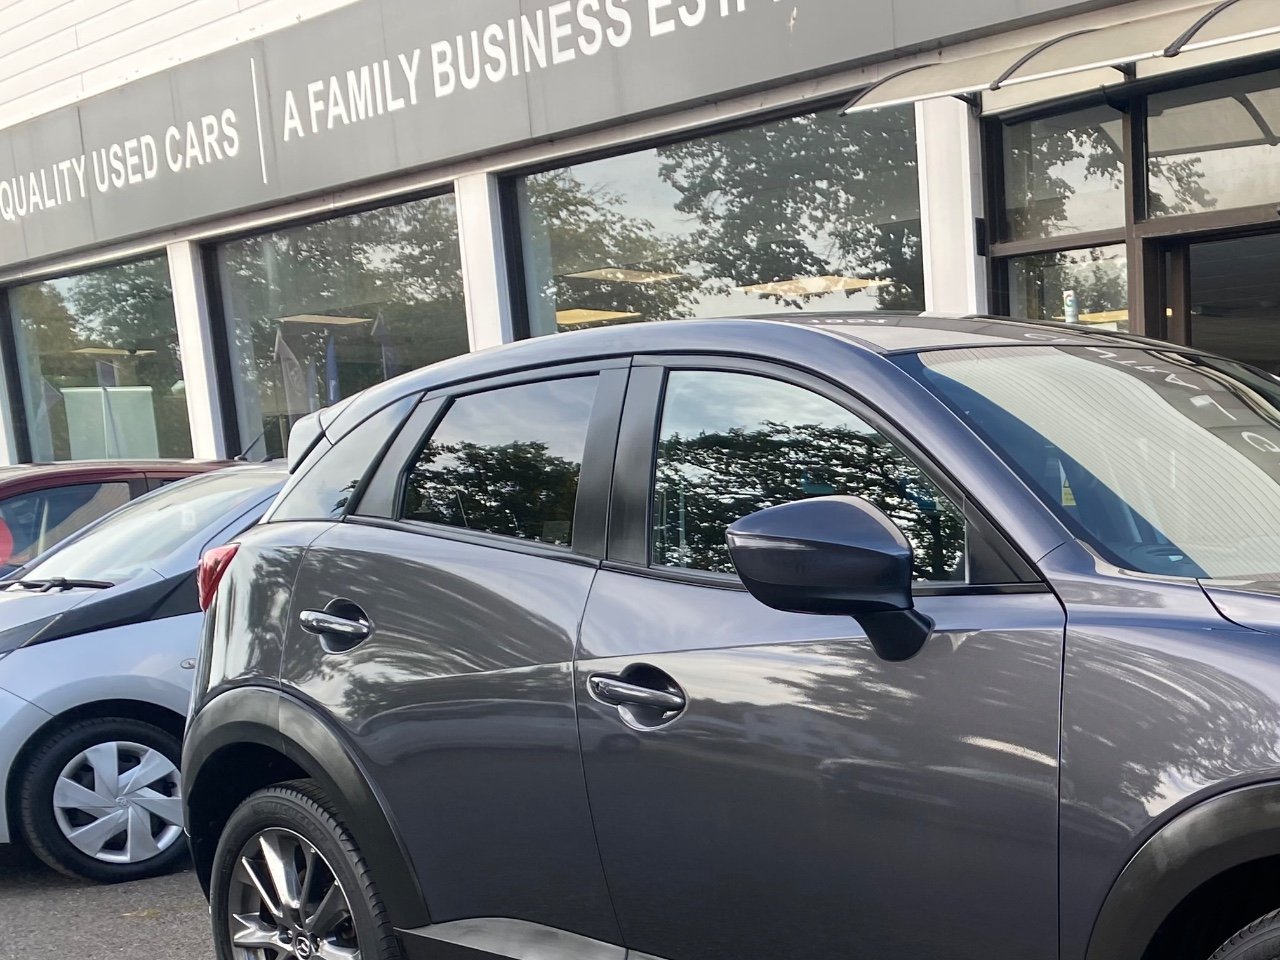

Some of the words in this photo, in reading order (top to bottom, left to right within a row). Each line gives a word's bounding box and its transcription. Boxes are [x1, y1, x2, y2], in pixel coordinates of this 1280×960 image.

[283, 90, 305, 142] A
[307, 49, 421, 133] FAMILY
[430, 0, 633, 99] BUSINESS
[0, 154, 86, 221] QUALITY
[92, 134, 158, 193] USED
[165, 108, 240, 172] CARS
